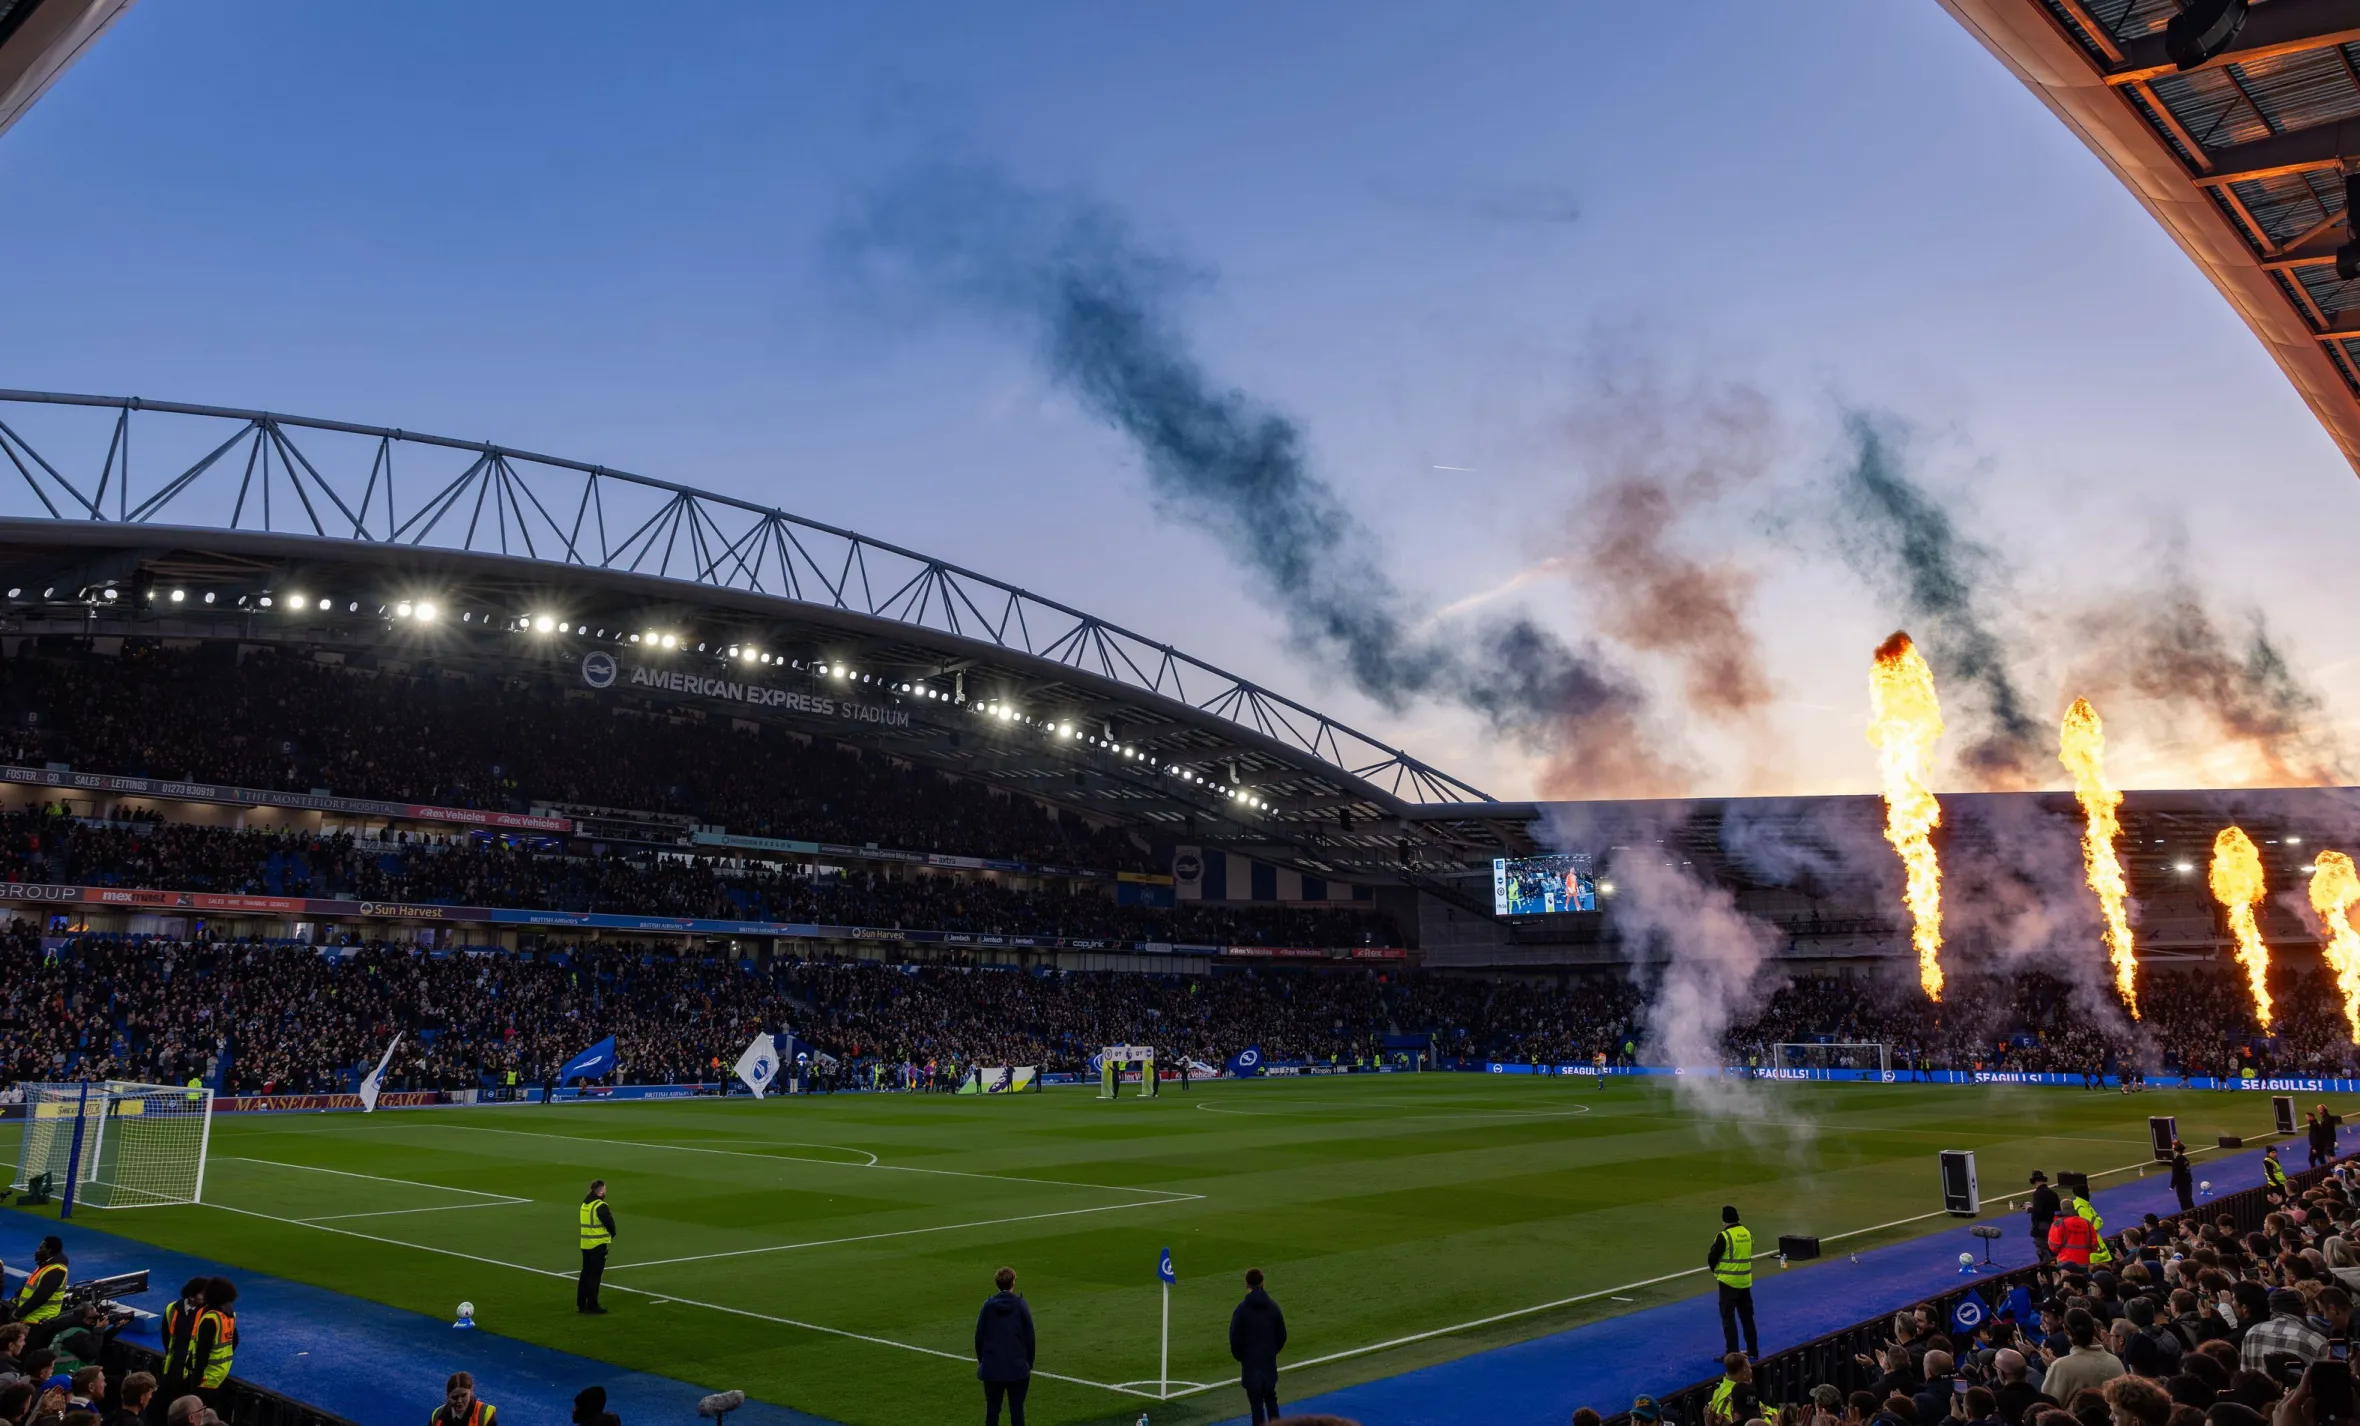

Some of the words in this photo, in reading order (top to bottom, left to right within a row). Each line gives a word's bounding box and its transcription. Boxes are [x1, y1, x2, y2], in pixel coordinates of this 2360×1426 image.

[631, 667, 742, 700] AMERICAN
[747, 686, 834, 715] EXPRESS
[841, 702, 909, 727] STADIUM
[6, 769, 36, 781] FOSTER
[47, 773, 60, 783] CO.
[74, 775, 100, 787] SALES
[111, 778, 147, 791] LETTINGS
[162, 783, 185, 794] 01273
[186, 785, 215, 797] 830919
[245, 793, 267, 801] THE
[272, 794, 345, 809] MONTEFIORE
[350, 802, 395, 813] HOSPITAL
[426, 809, 444, 819] Rex
[446, 810, 486, 822] Vehicles
[504, 815, 521, 825] Rex
[522, 817, 560, 829] Vehicles
[375, 905, 395, 915] Sun
[399, 906, 442, 917] Harvest
[530, 916, 553, 924] BRITISH
[861, 929, 876, 938] Sun
[877, 930, 905, 940] Harvest
[1364, 948, 1382, 957] Rex
[1562, 1066, 1612, 1075] SEAGULS!
[234, 1095, 322, 1112] MANSELL
[327, 1093, 428, 1110] McTGART
